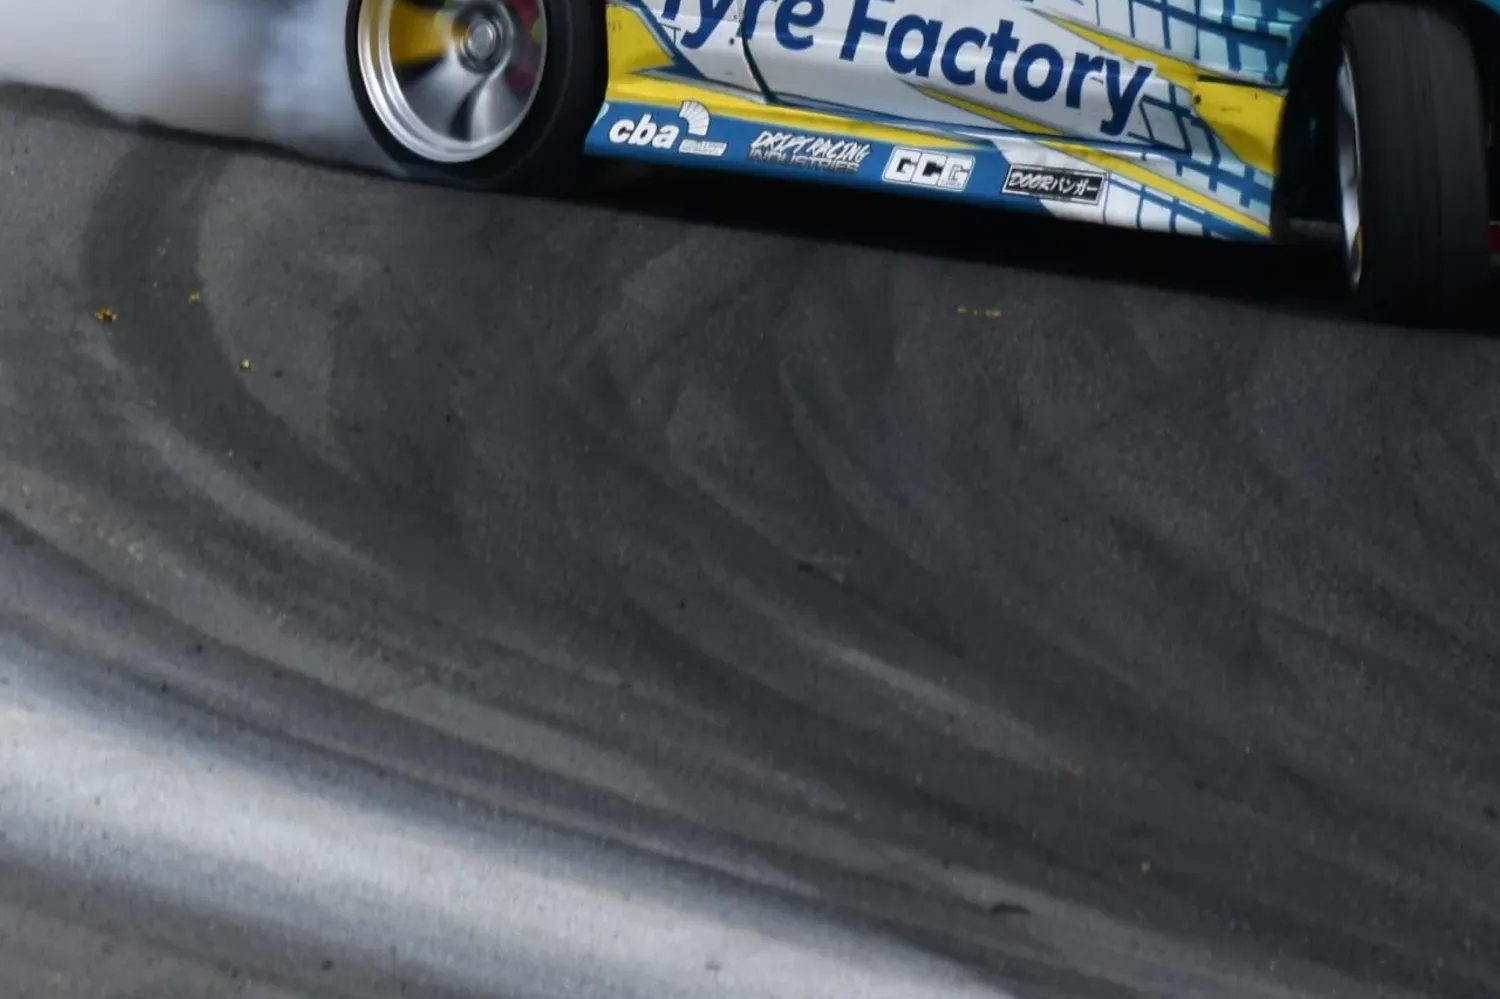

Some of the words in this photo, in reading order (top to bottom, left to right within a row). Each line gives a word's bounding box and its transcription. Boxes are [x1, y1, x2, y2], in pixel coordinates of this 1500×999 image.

[609, 113, 680, 149] cba
[751, 130, 809, 154] DRIFT
[809, 139, 870, 163] RACING
[887, 149, 974, 187] GCG
